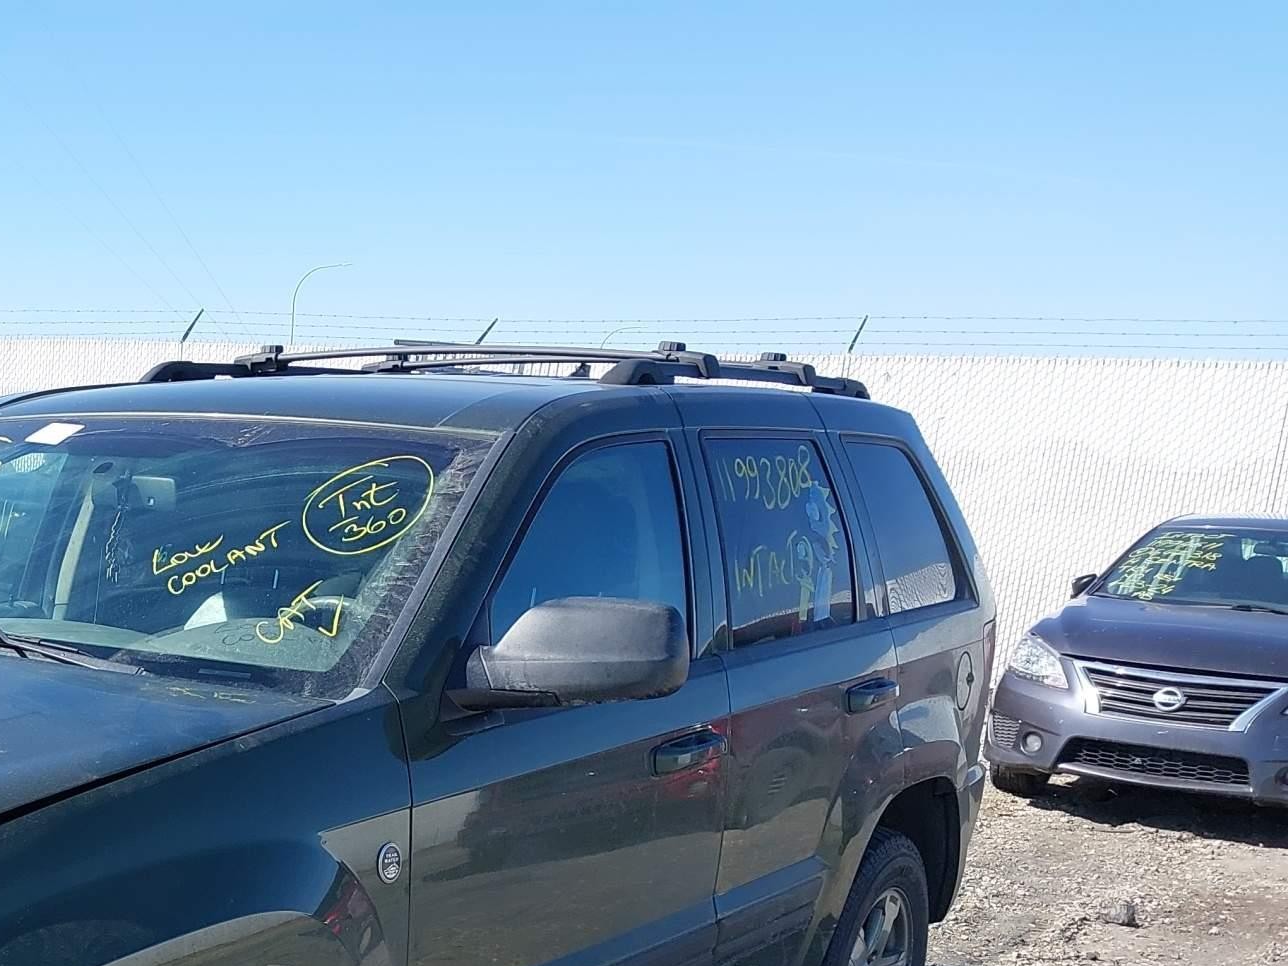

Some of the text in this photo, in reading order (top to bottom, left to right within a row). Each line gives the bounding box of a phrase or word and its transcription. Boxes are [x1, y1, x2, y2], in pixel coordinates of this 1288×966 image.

[715, 445, 811, 510] 11993808
[329, 507, 407, 542] 360
[167, 521, 291, 595] COOLANT
